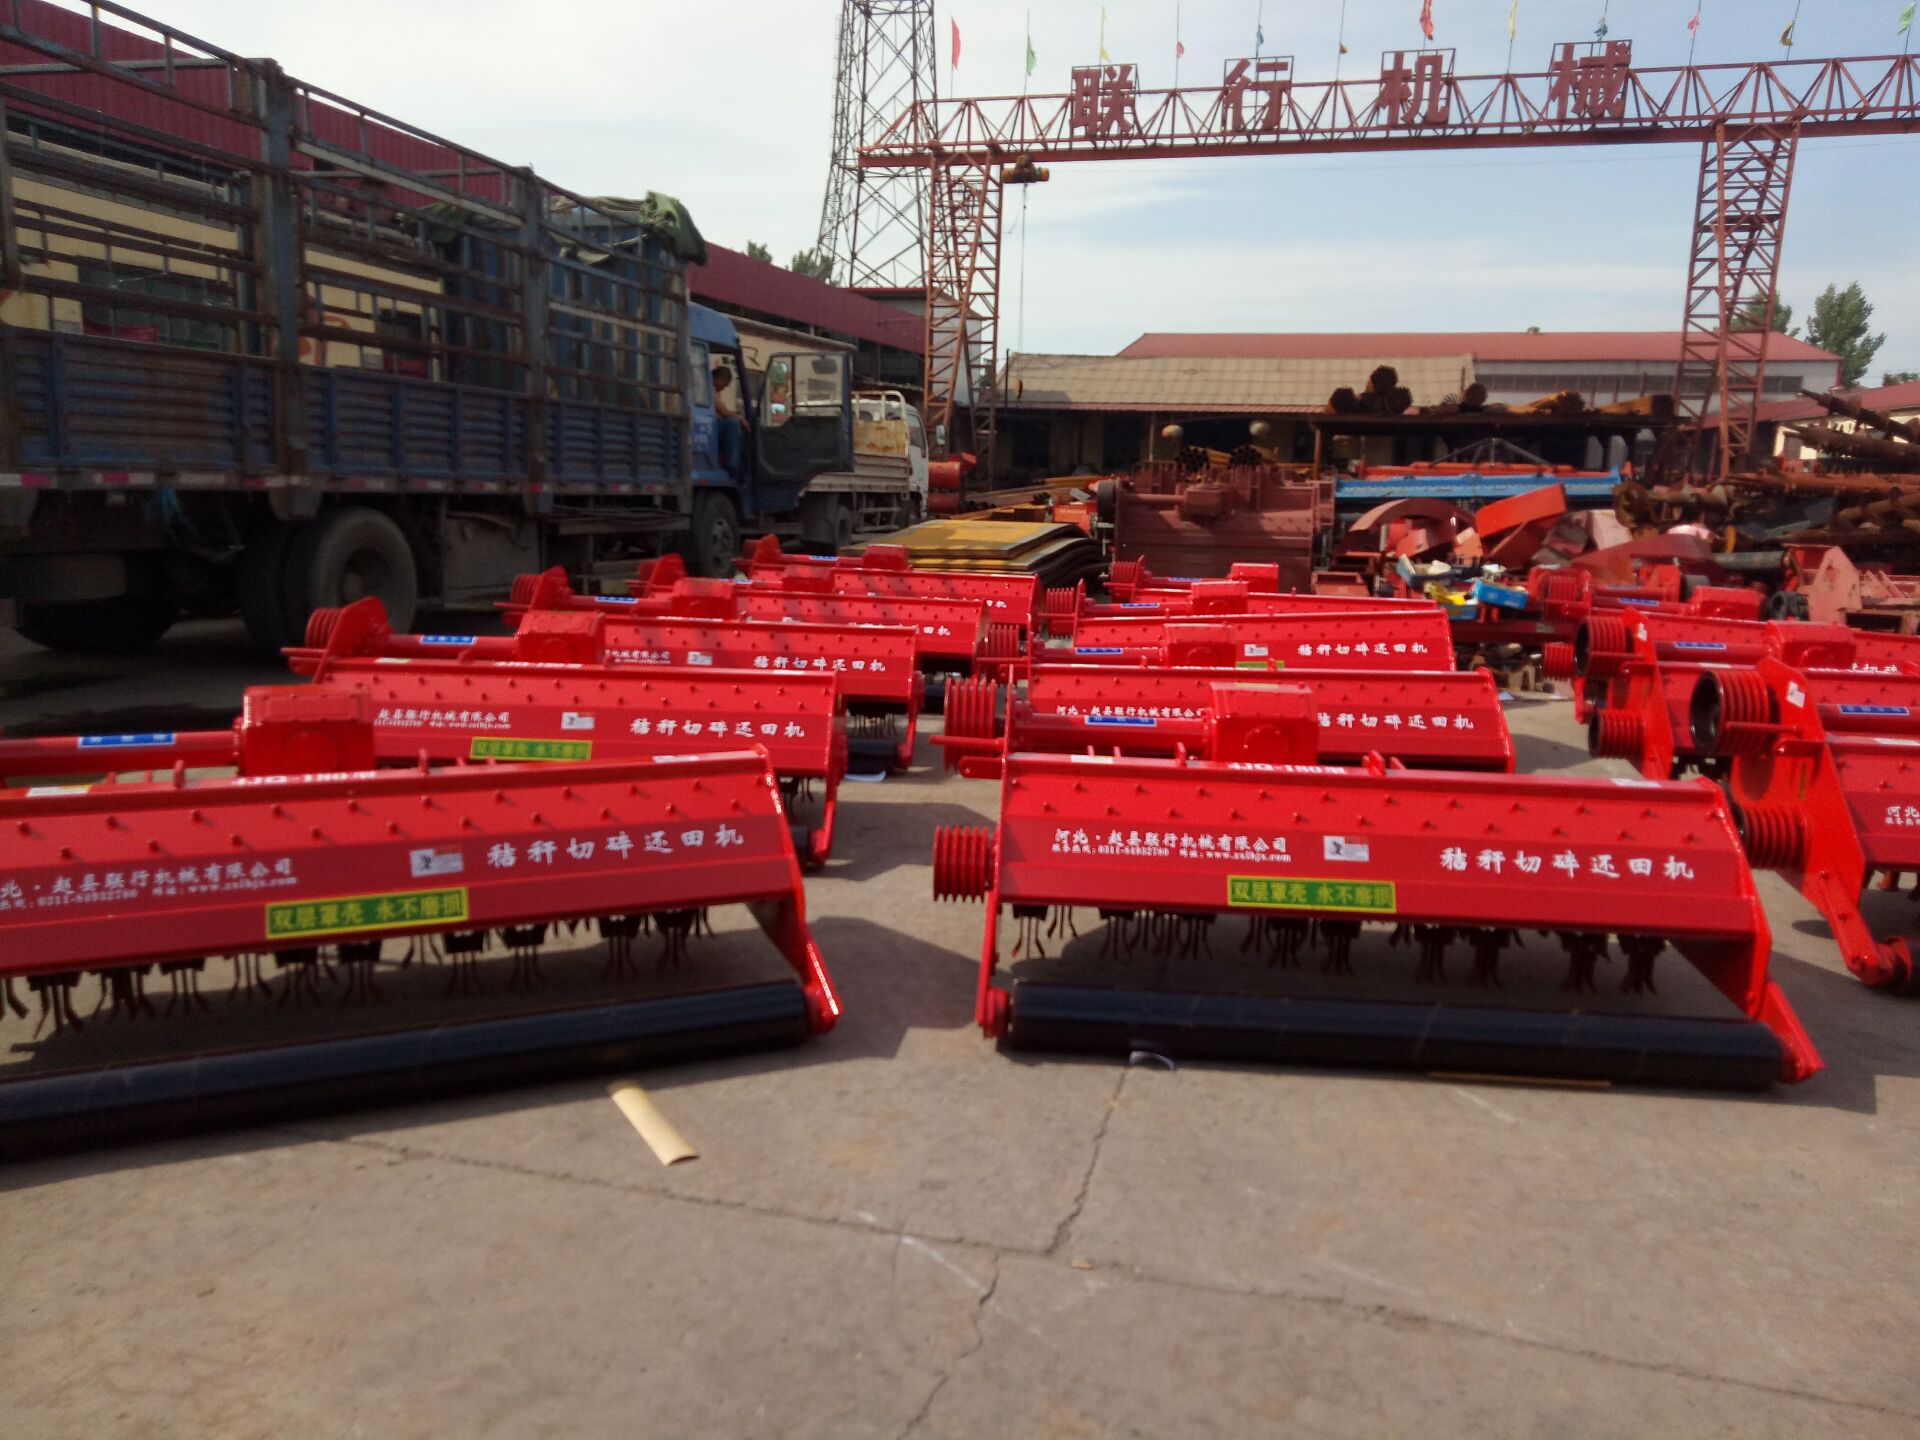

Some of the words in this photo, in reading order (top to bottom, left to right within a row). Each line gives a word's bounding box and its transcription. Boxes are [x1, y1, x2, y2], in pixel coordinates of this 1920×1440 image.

[1070, 40, 1632, 134] 联行机械
[486, 823, 745, 869] 秸秆切碎还田机
[1439, 846, 1695, 879] 秸秆切碎还田机
